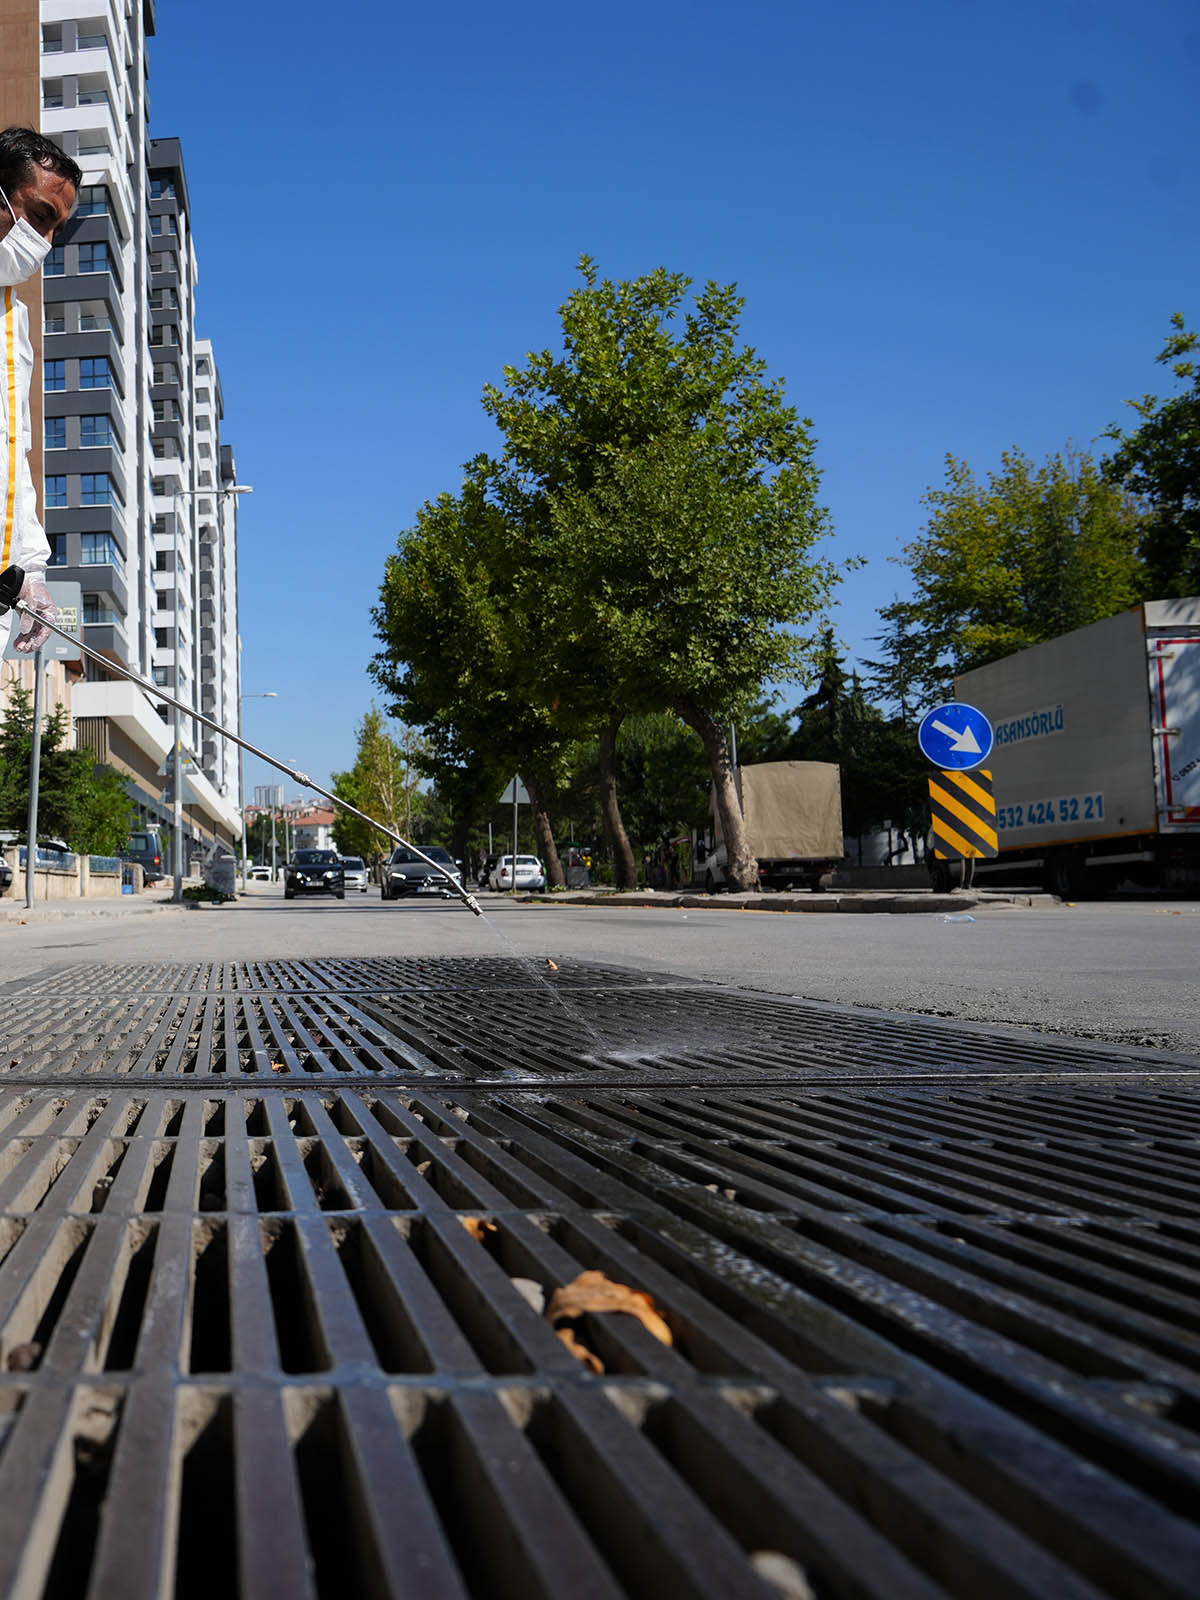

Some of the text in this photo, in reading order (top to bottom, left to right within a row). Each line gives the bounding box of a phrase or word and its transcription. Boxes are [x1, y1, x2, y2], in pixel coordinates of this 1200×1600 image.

[995, 703, 1064, 746] ASANSÖRLÜ
[1027, 801, 1056, 825] 424
[1059, 797, 1079, 822] 52
[1084, 794, 1103, 819] 21
